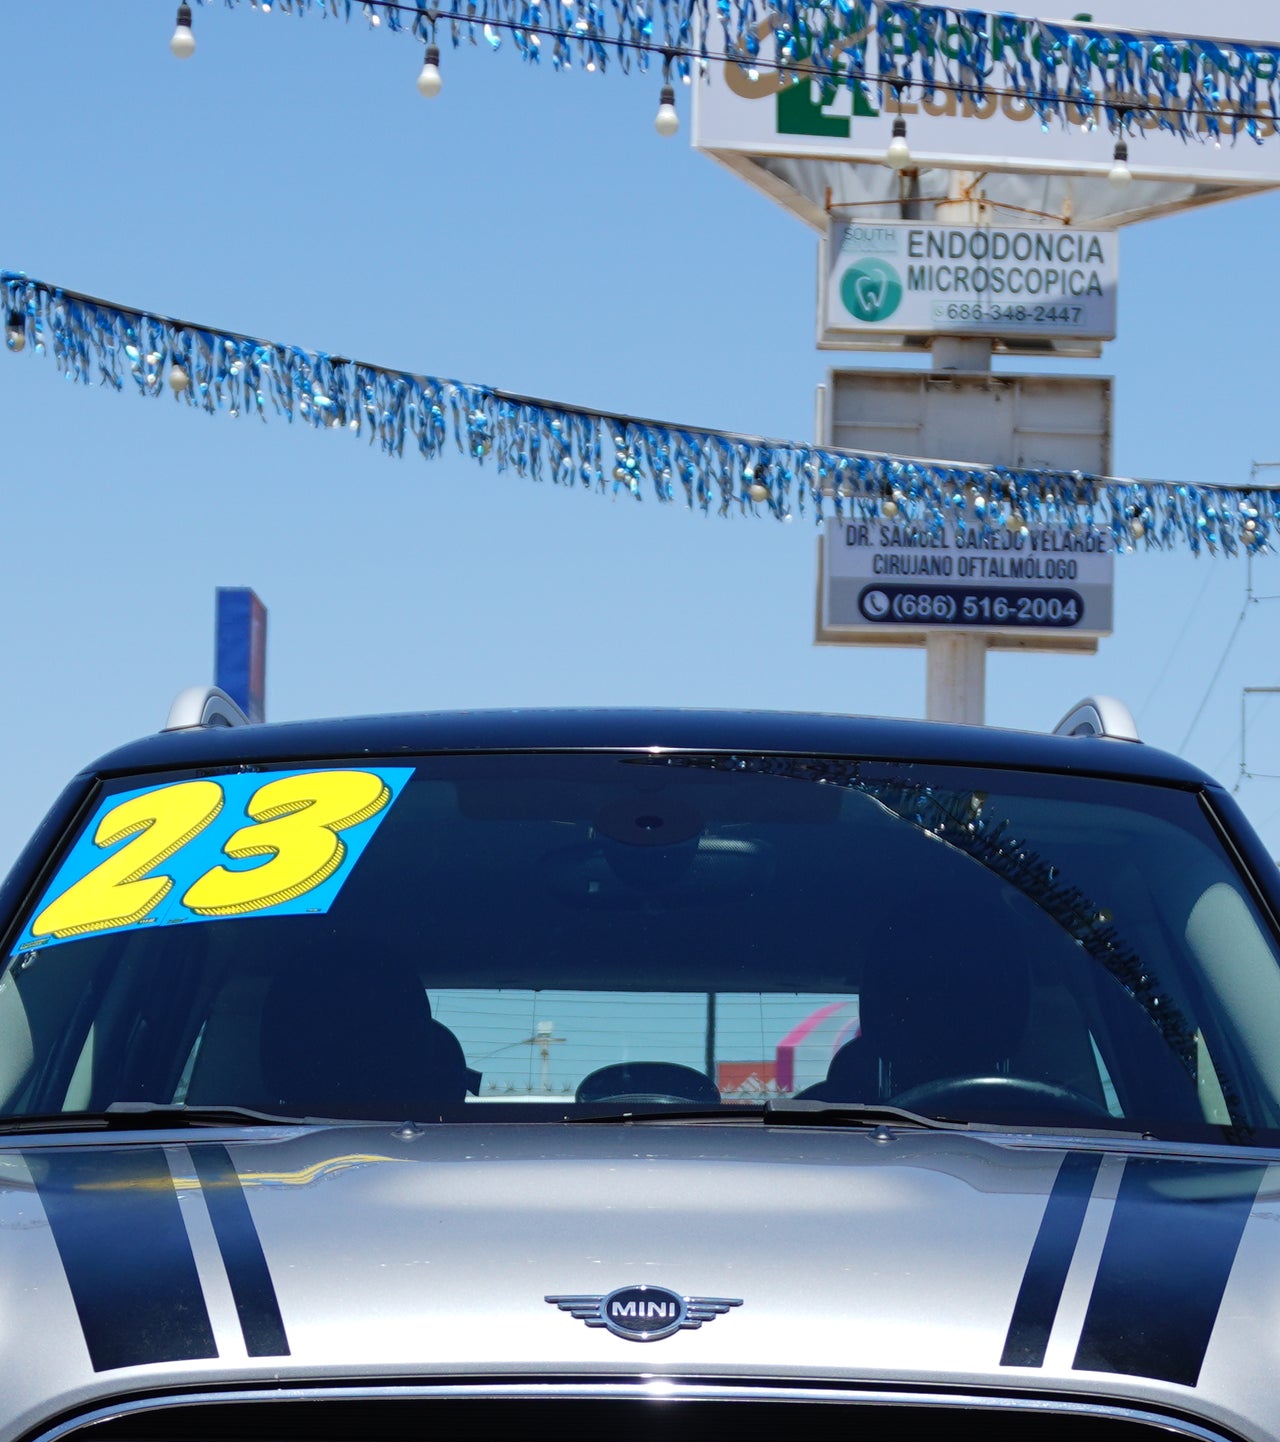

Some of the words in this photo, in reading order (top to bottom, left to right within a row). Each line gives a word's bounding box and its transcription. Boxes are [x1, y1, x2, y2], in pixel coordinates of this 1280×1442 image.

[907, 229, 1105, 264] ENDODONCIA
[907, 264, 1103, 297] MICROSCOPICA
[946, 303, 1083, 324] 686-348-2447
[846, 524, 874, 547] DR.
[872, 553, 953, 577] CIRUJANO
[958, 553, 1078, 580] OFTALMÓLOGO
[892, 592, 957, 619] (686)
[962, 594, 1078, 621] 516-2004
[31, 769, 392, 939] 23
[611, 1301, 676, 1318] MINI
